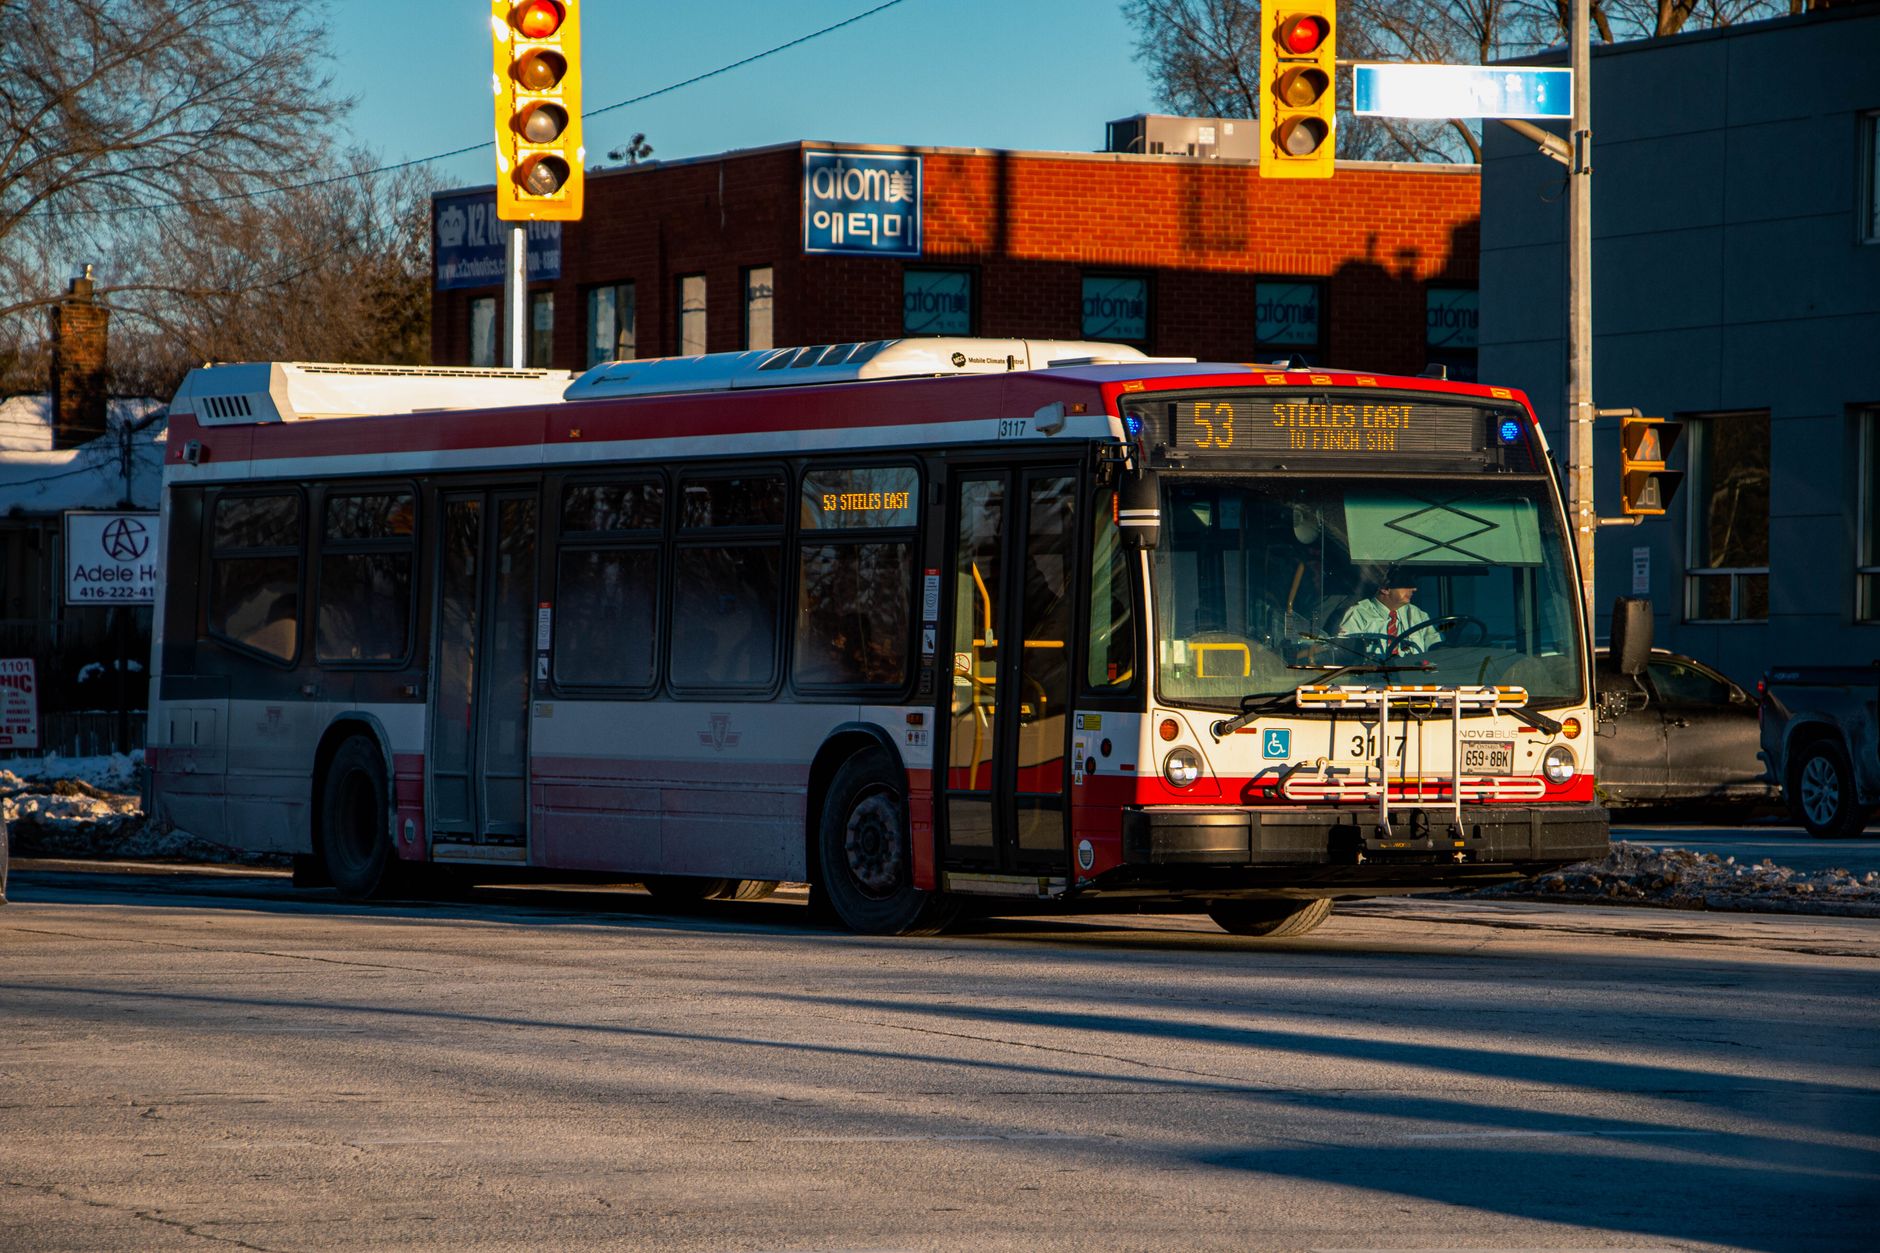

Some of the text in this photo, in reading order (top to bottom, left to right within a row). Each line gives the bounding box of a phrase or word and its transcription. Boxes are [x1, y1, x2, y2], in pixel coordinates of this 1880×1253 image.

[813, 210, 912, 247] 애터미
[1001, 421, 1026, 437] 3117
[1194, 402, 1413, 448] 53 STEELES EAST
[1289, 429, 1394, 450] TO FINCH STN
[823, 492, 909, 511] 53 STEELES EAST
[73, 565, 157, 582] Adele H
[80, 586, 154, 598] 416-222-41
[1465, 750, 1509, 767] 659 8BK
